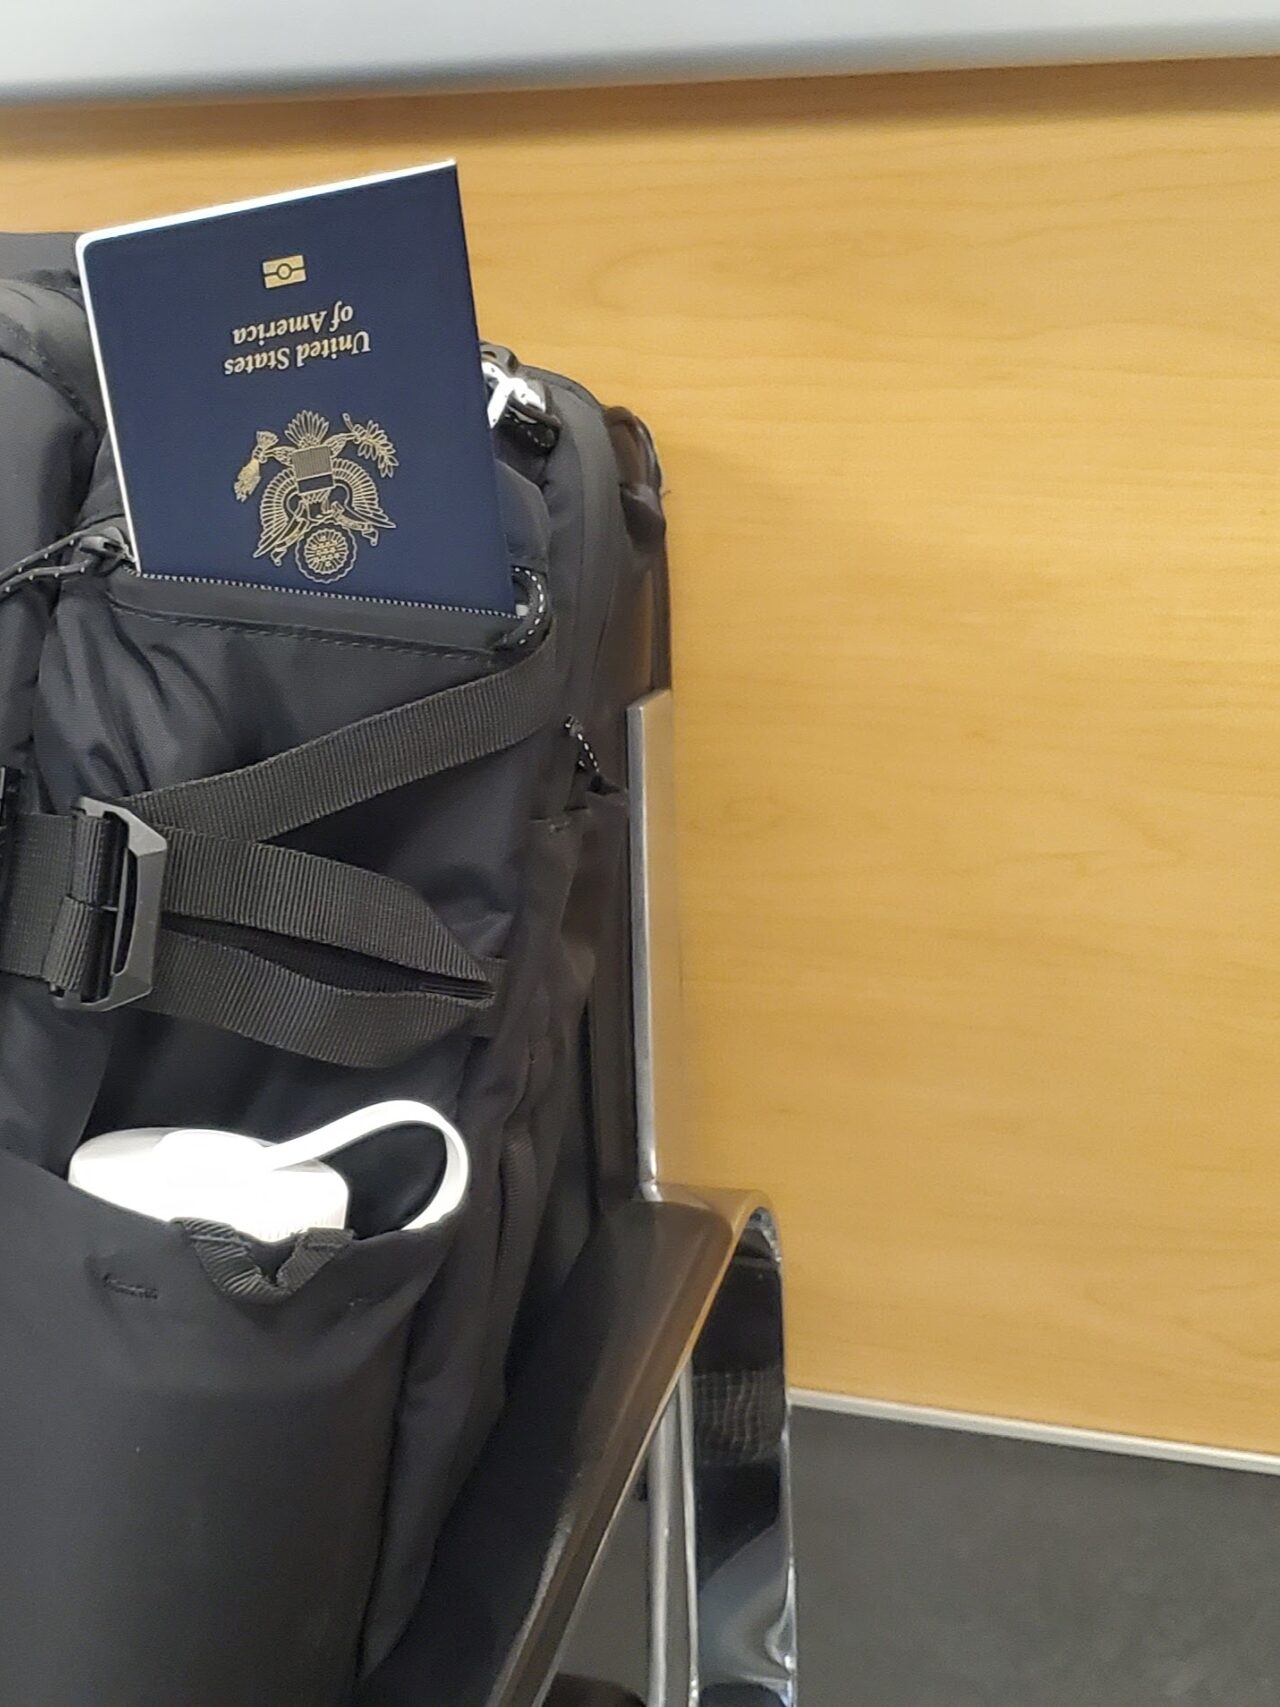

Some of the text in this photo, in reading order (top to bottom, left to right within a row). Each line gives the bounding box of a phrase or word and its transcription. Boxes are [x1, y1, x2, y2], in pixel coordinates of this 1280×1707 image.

[231, 300, 354, 346] of America
[223, 330, 372, 375] United States
